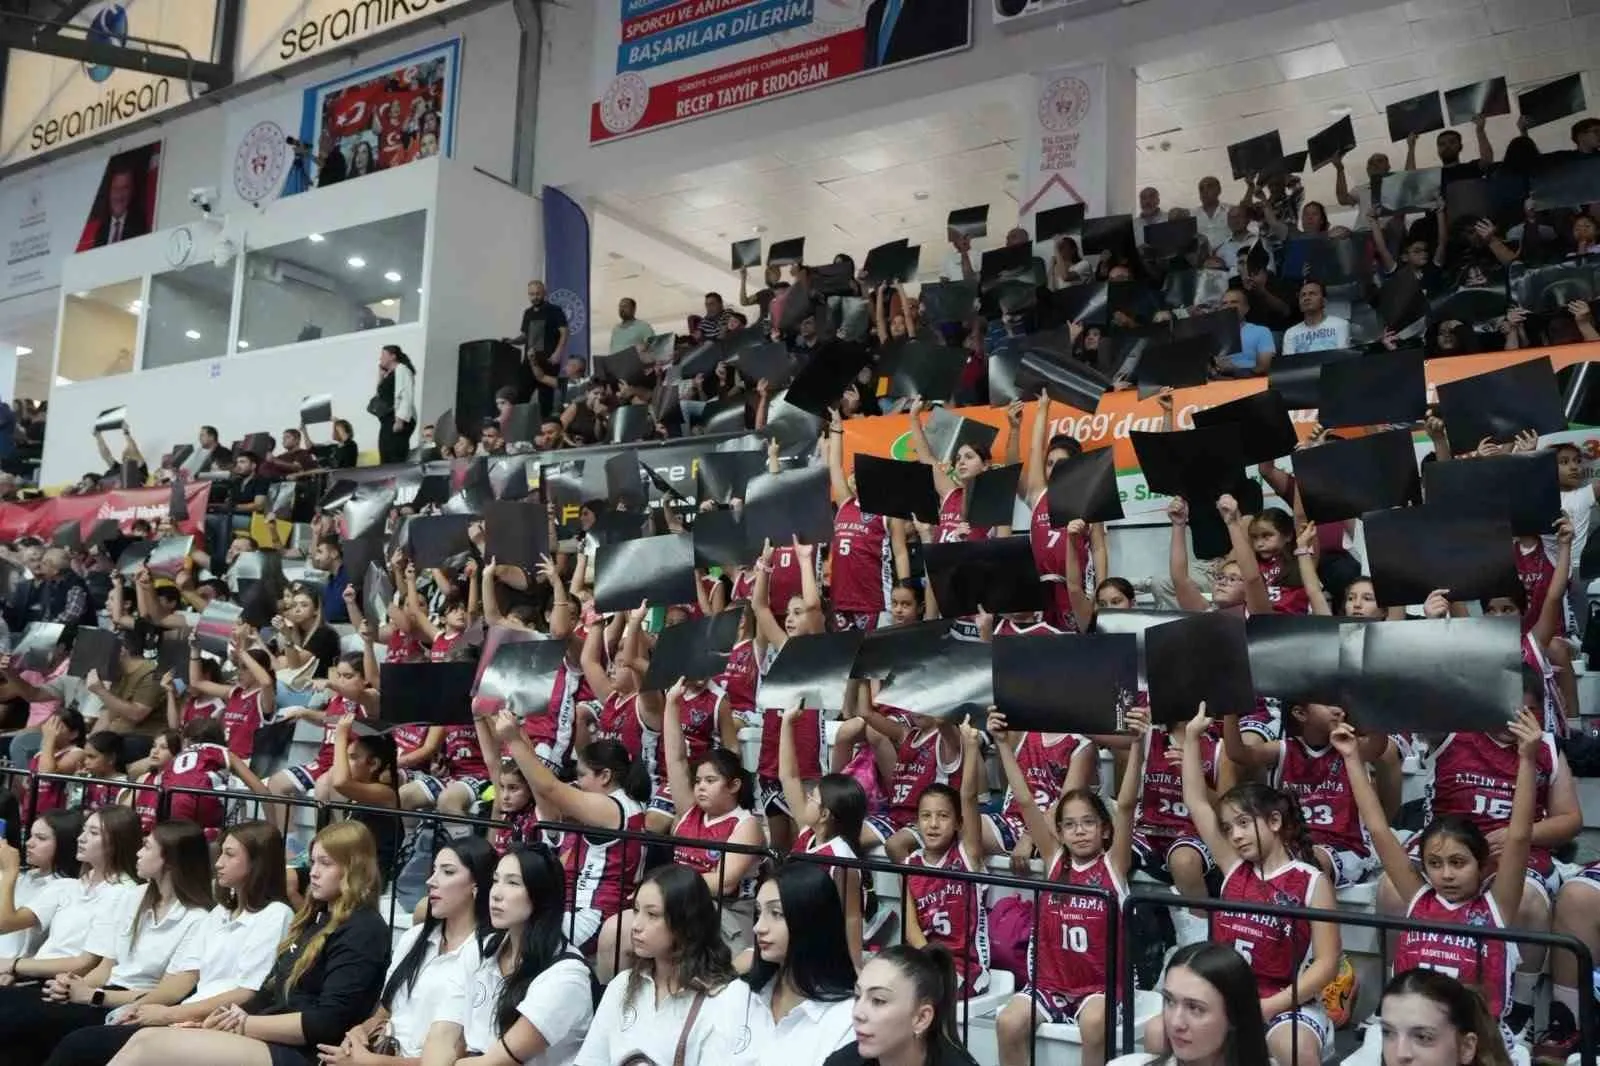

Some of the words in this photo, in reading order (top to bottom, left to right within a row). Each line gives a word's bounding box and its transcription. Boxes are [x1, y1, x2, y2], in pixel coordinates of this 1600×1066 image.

[624, 11, 676, 39] SPORCU
[676, 5, 694, 21] VE
[628, 25, 727, 64] BAŞARILAR
[675, 95, 714, 118] RECEP
[717, 78, 760, 108] TAYYİP
[763, 62, 830, 96] ERDOĞAN
[31, 78, 169, 150] seramiksan
[840, 539, 852, 556] 5
[1047, 530, 1061, 548] 7
[780, 553, 792, 568] 0
[173, 751, 198, 775] 0
[1144, 773, 1172, 785] ALTIN
[1455, 773, 1496, 787] ALTIN
[1159, 798, 1189, 817] 20
[1301, 804, 1334, 825] 23
[1070, 896, 1104, 912] ARMA
[1061, 923, 1089, 953] 10
[1420, 947, 1461, 961] BASKETBALL
